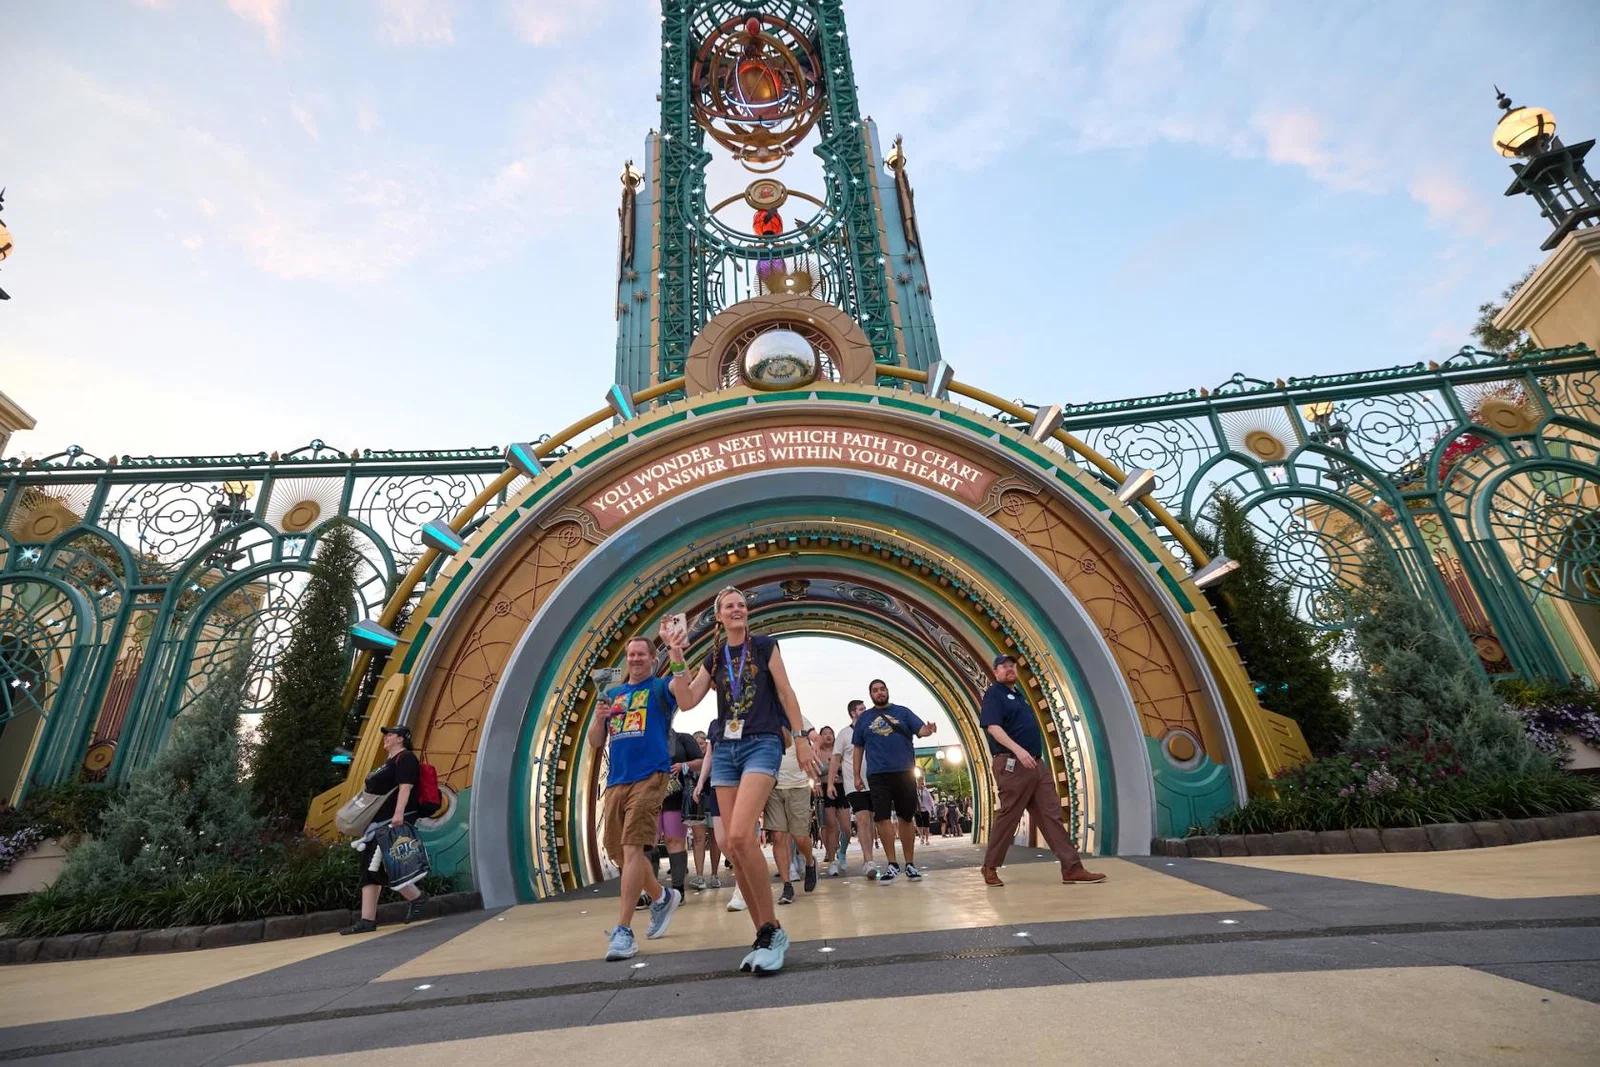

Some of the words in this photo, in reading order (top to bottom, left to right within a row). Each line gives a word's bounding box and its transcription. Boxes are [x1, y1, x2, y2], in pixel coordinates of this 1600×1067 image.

[593, 482, 632, 512] YOU
[634, 446, 713, 487] WONDER
[718, 433, 763, 455] NEXT
[770, 430, 837, 444] WHICH
[842, 432, 887, 451] PATH
[892, 440, 918, 458] TO
[921, 450, 983, 483] CHART
[616, 489, 655, 515] THE
[656, 458, 728, 496] ANSWER
[731, 450, 766, 468] LIES
[769, 446, 843, 460] WITHIN
[847, 448, 899, 470] YOUR
[902, 460, 964, 492] HEART
